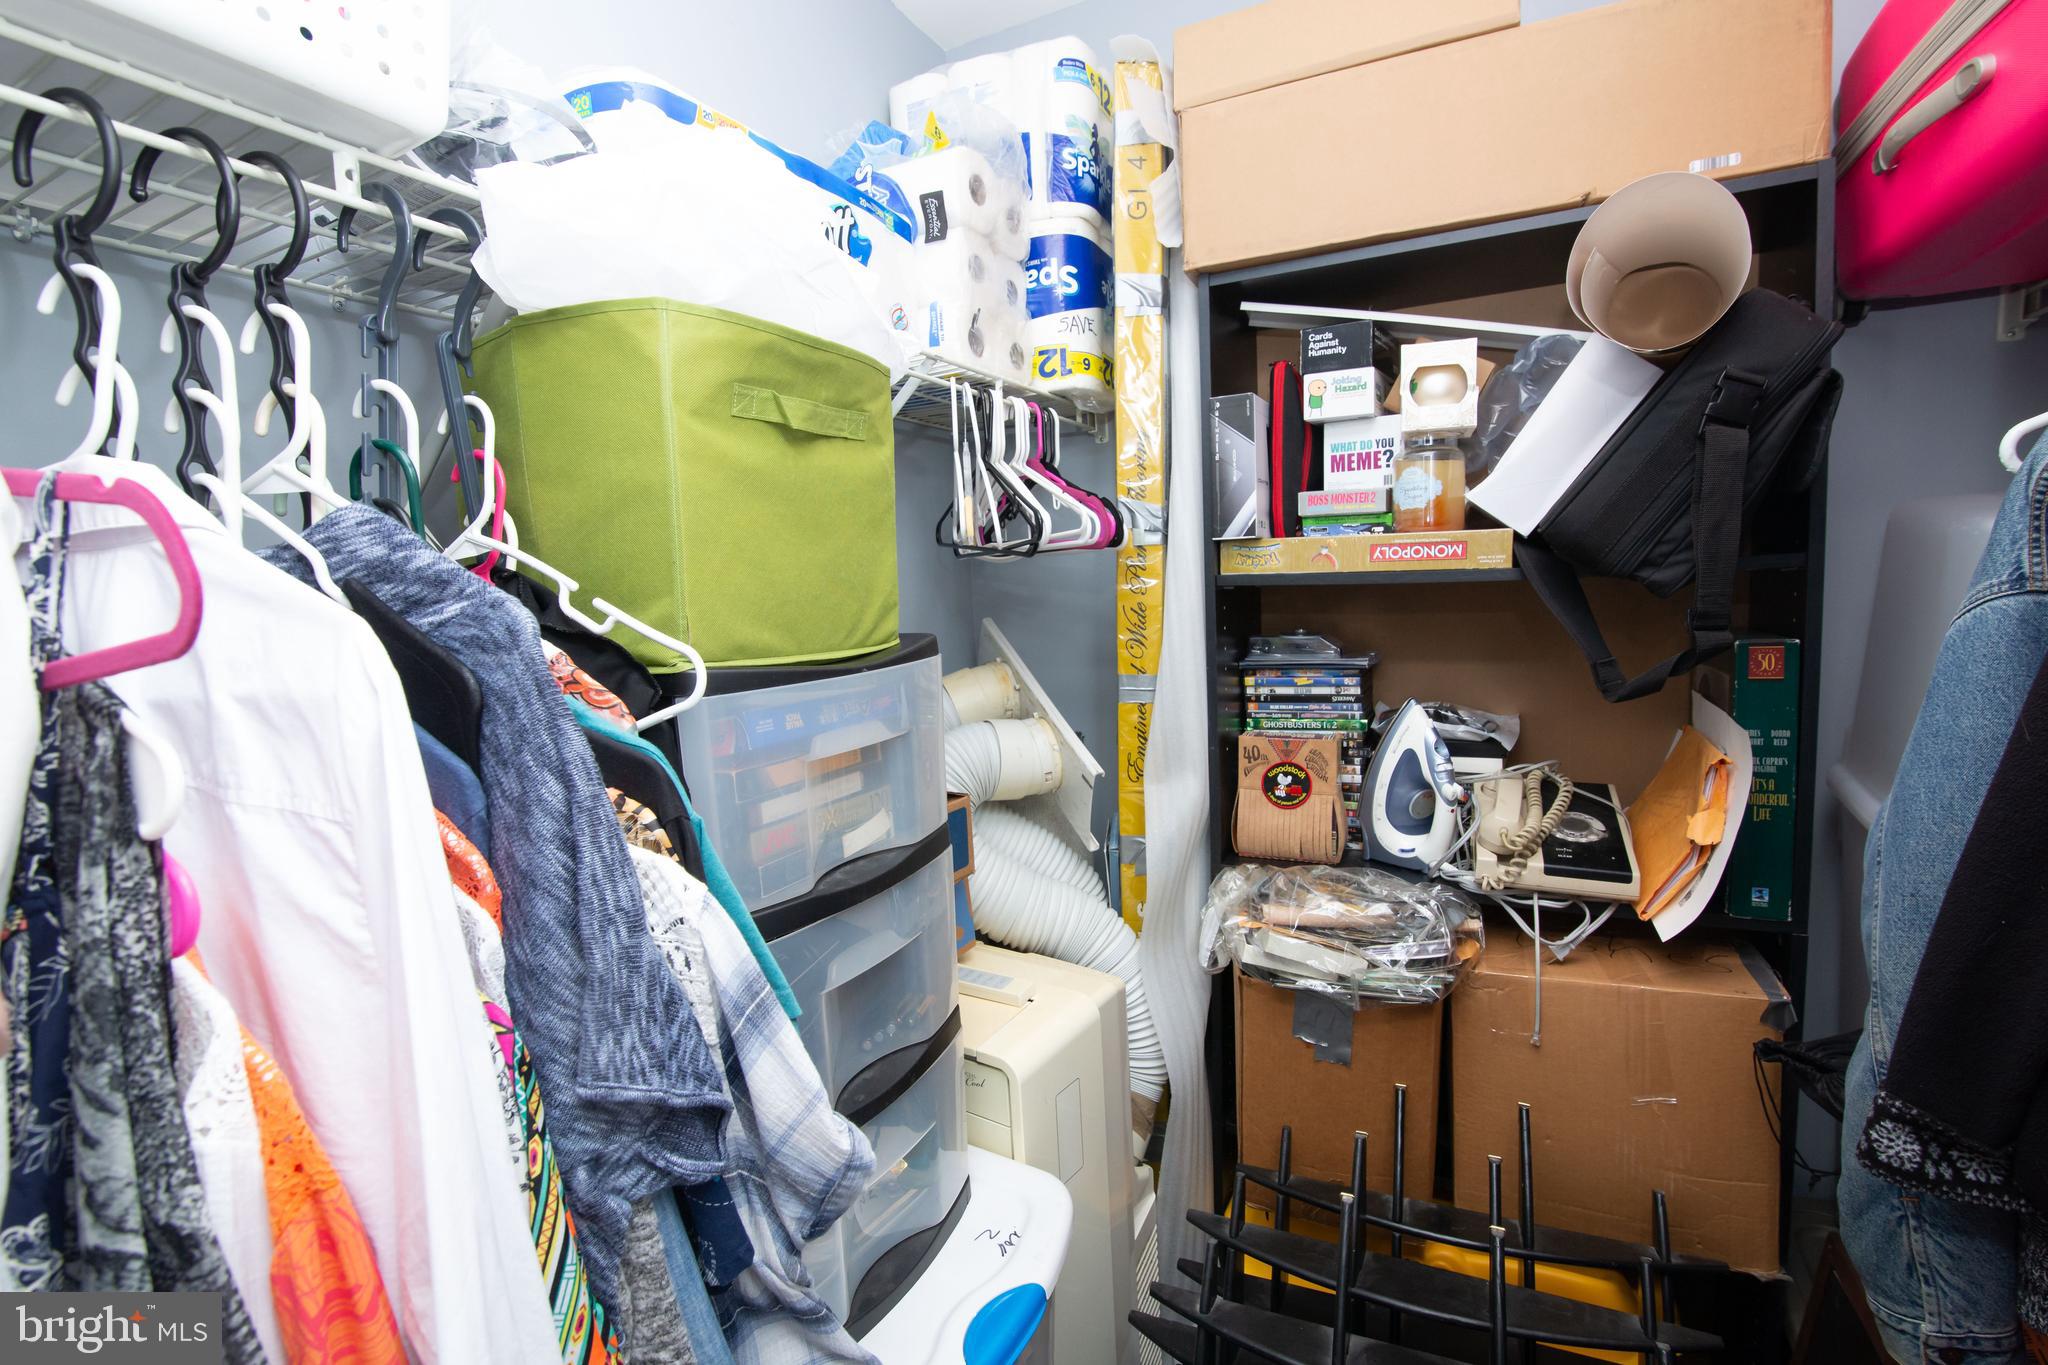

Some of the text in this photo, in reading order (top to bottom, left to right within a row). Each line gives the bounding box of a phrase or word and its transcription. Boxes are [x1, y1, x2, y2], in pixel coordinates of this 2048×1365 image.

[573, 95, 590, 113] 20
[702, 110, 714, 122] 20
[1127, 154, 1148, 170] 4
[928, 197, 941, 238] Essential
[1057, 314, 1098, 337] SAVE
[1308, 331, 1333, 342] Cards
[1308, 338, 1339, 350] Against
[1308, 345, 1347, 357] Humanity
[1037, 347, 1091, 379] 6 12
[1331, 375, 1363, 386] Joking
[1334, 381, 1368, 393] Hazard
[1330, 437, 1395, 453] WHAT DO YOU
[1330, 449, 1395, 473] MEME?
[1307, 493, 1329, 507] BOSS
[1330, 492, 1369, 505] MONSTER
[1369, 491, 1377, 503] 2
[1372, 543, 1463, 560] MONOPOLY
[1122, 603, 1148, 661] Wide
[1758, 653, 1775, 671] 50
[1262, 720, 1321, 729] GHOSTBUSTERS
[1773, 738, 1788, 746] REED
[1243, 745, 1261, 764] 40
[1762, 756, 1789, 767] CAPRA'S
[1267, 764, 1307, 780] woodstock
[1768, 778, 1775, 791] A
[1747, 792, 1790, 807] ONDERFUL
[1753, 805, 1773, 822] LIFE
[965, 1078, 987, 1088] Cool
